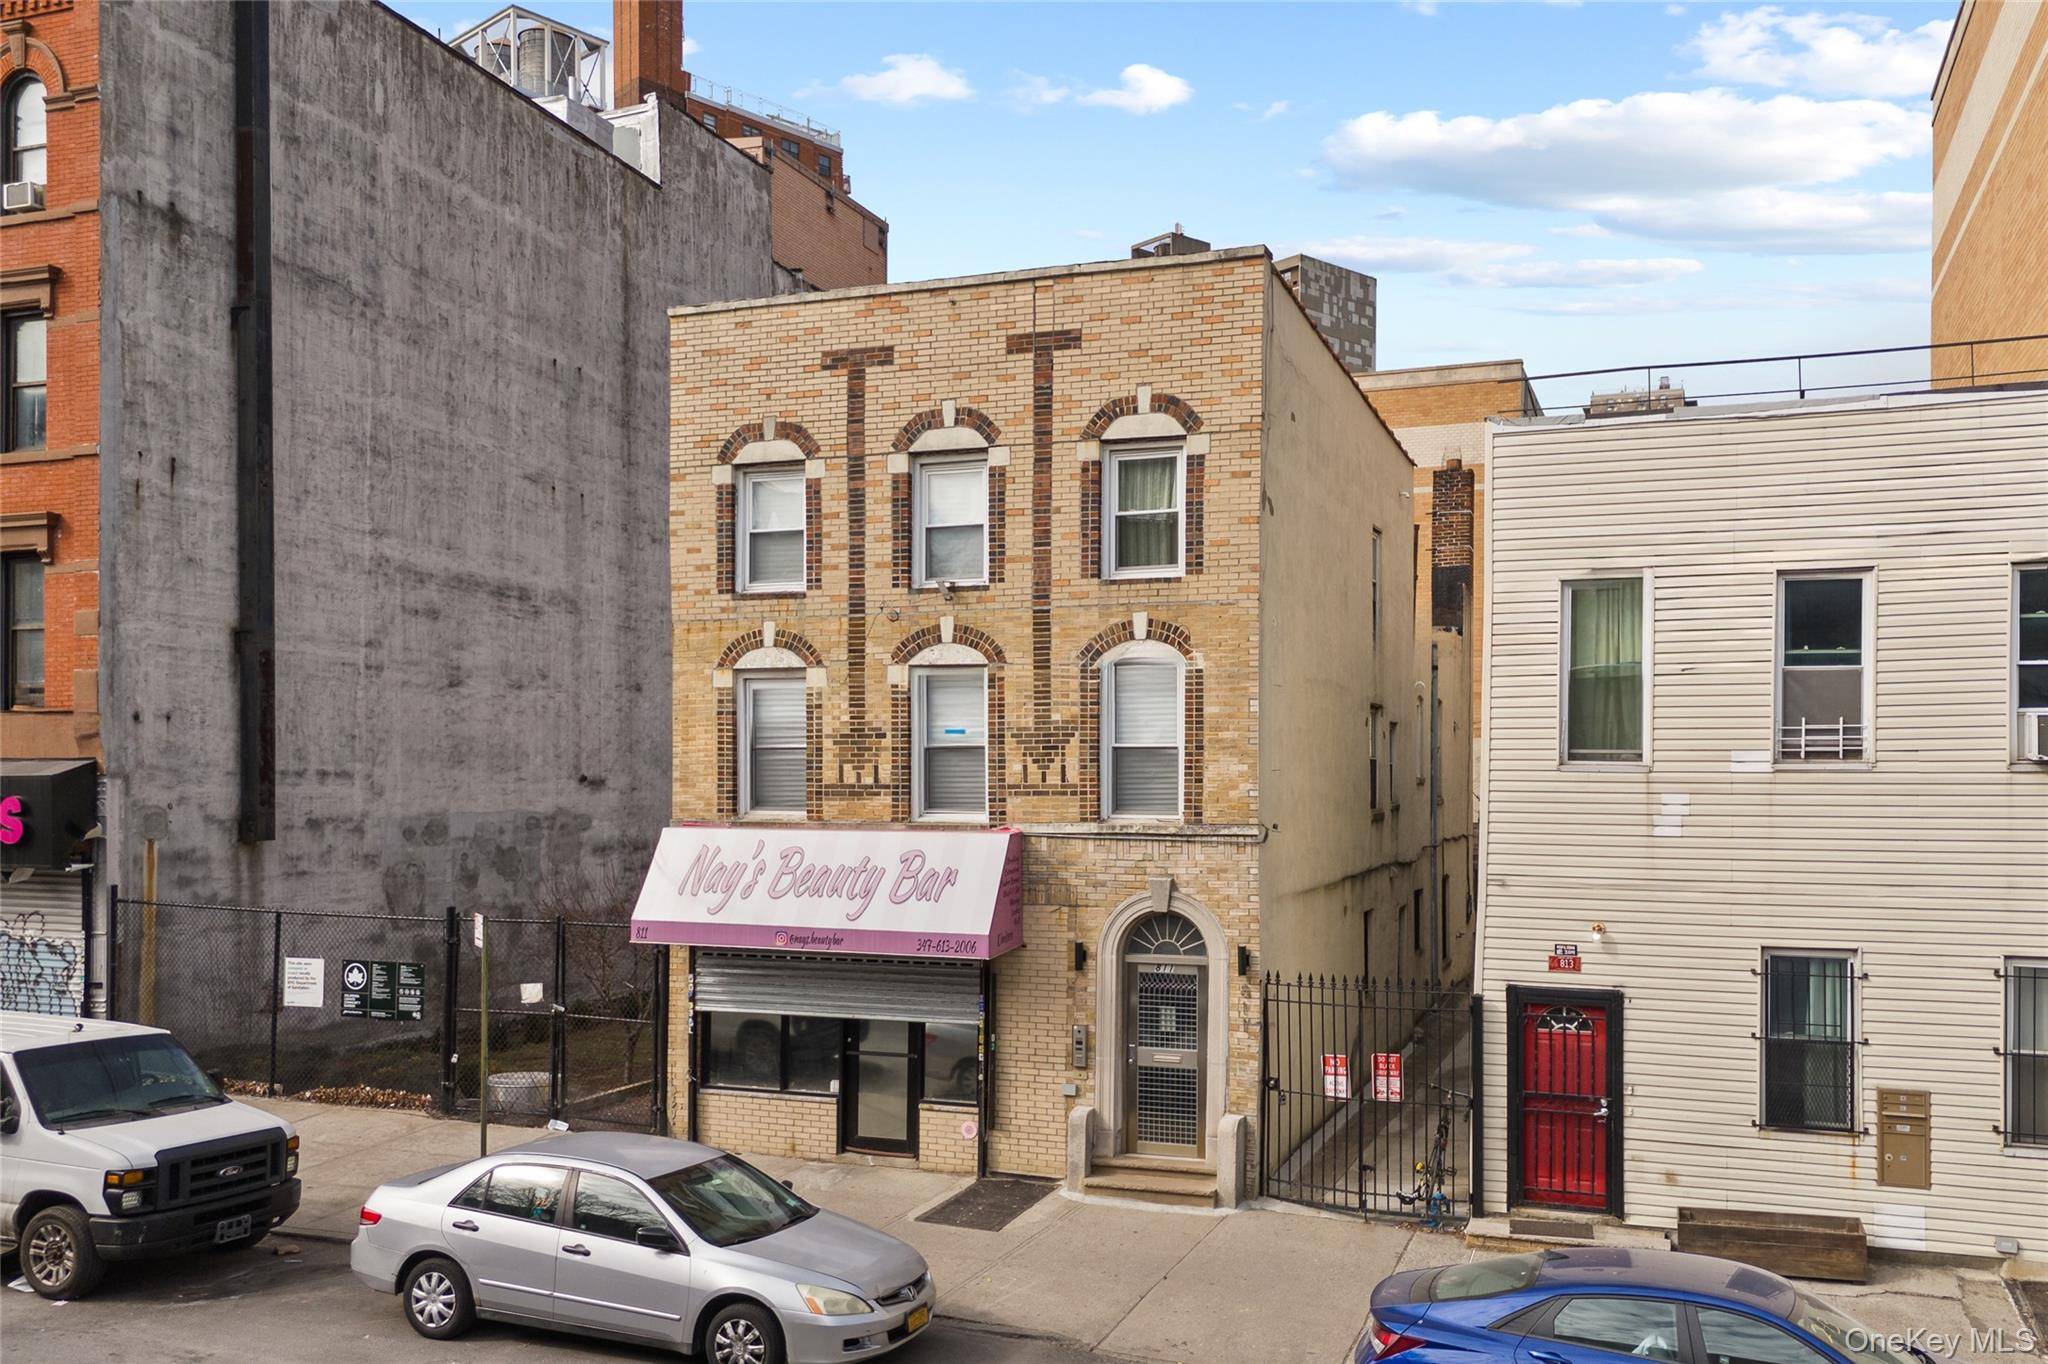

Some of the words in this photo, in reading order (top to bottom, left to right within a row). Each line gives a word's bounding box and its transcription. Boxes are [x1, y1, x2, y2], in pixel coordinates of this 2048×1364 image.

[678, 839, 767, 915] Nay's
[768, 846, 886, 921] Beauty
[889, 850, 958, 904] Bar
[635, 926, 648, 939] 811
[916, 938, 977, 954] 347-613-2006
[1155, 963, 1174, 972] 811
[1560, 959, 1574, 968] 813
[1325, 1066, 1347, 1074] PARING
